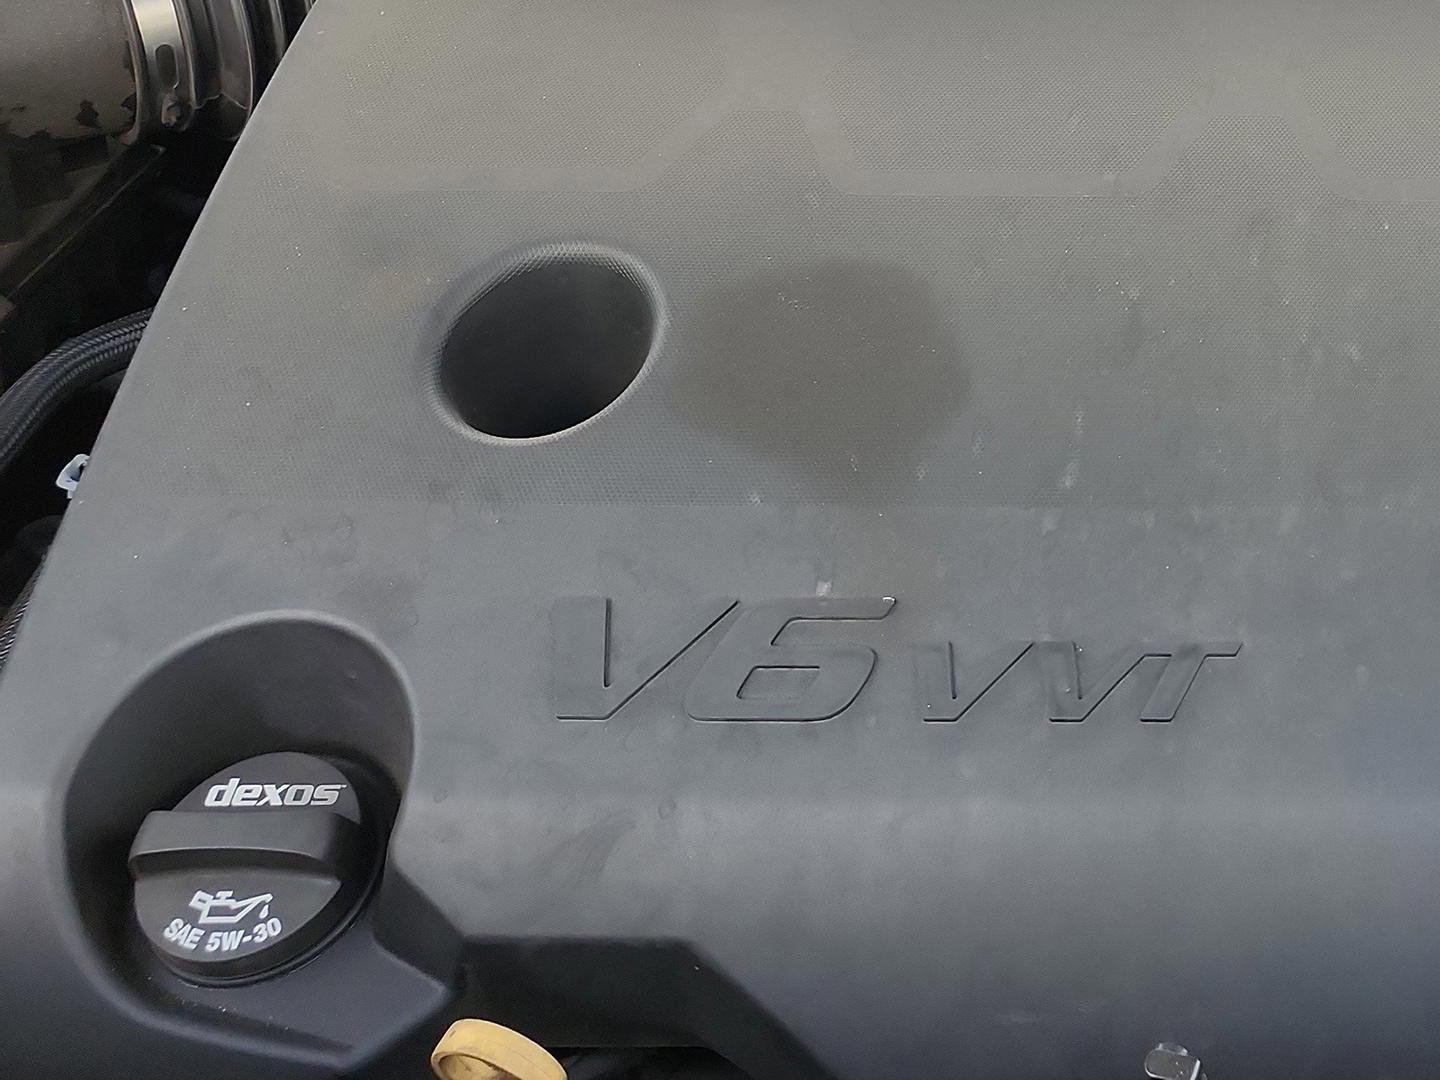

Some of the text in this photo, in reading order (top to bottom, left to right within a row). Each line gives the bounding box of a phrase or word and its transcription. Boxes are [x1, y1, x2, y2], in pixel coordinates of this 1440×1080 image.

[554, 595, 1244, 723] V6 VVT
[204, 778, 342, 807] dexos
[163, 918, 283, 953] SAE 5W-30
